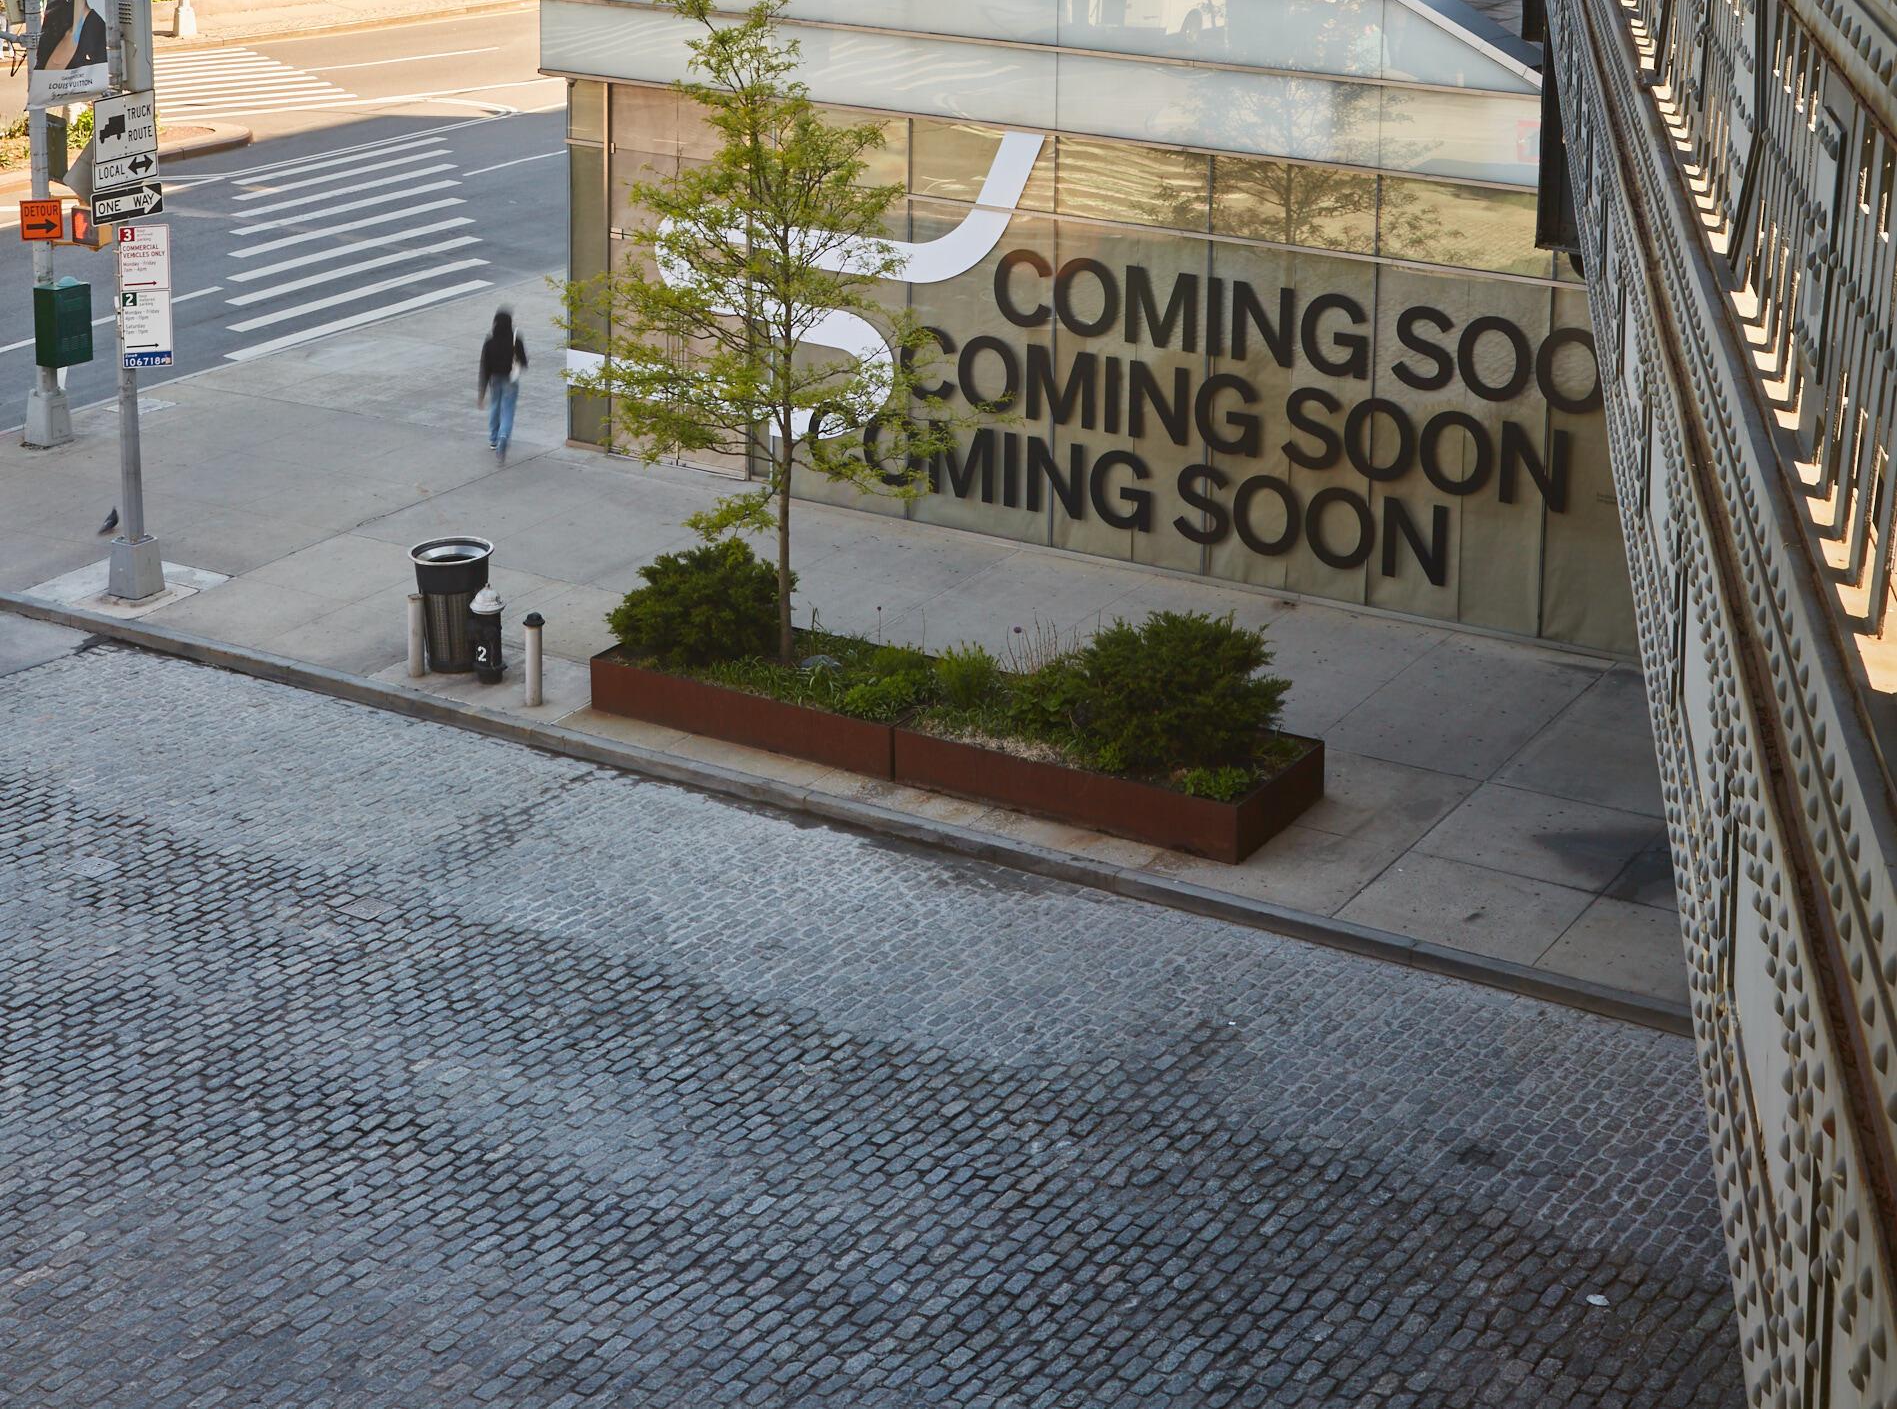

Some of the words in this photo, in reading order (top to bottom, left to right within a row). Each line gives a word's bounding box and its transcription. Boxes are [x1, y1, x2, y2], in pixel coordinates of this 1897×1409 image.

[127, 104, 152, 120] TRUCK
[128, 125, 153, 142] ROUTE
[98, 163, 126, 180] LOCAL
[24, 204, 59, 218] DETOUR
[98, 199, 121, 215] ONE
[132, 193, 155, 208] WAY
[123, 229, 132, 241] 3
[125, 293, 134, 306] 2
[993, 248, 1369, 380] COMING
[1390, 304, 1604, 414] SOO
[124, 356, 161, 367] 106718
[899, 325, 1262, 458] COMING
[1280, 387, 1572, 514] SOON
[1172, 463, 1449, 587] SOON
[477, 646, 487, 662] 2
